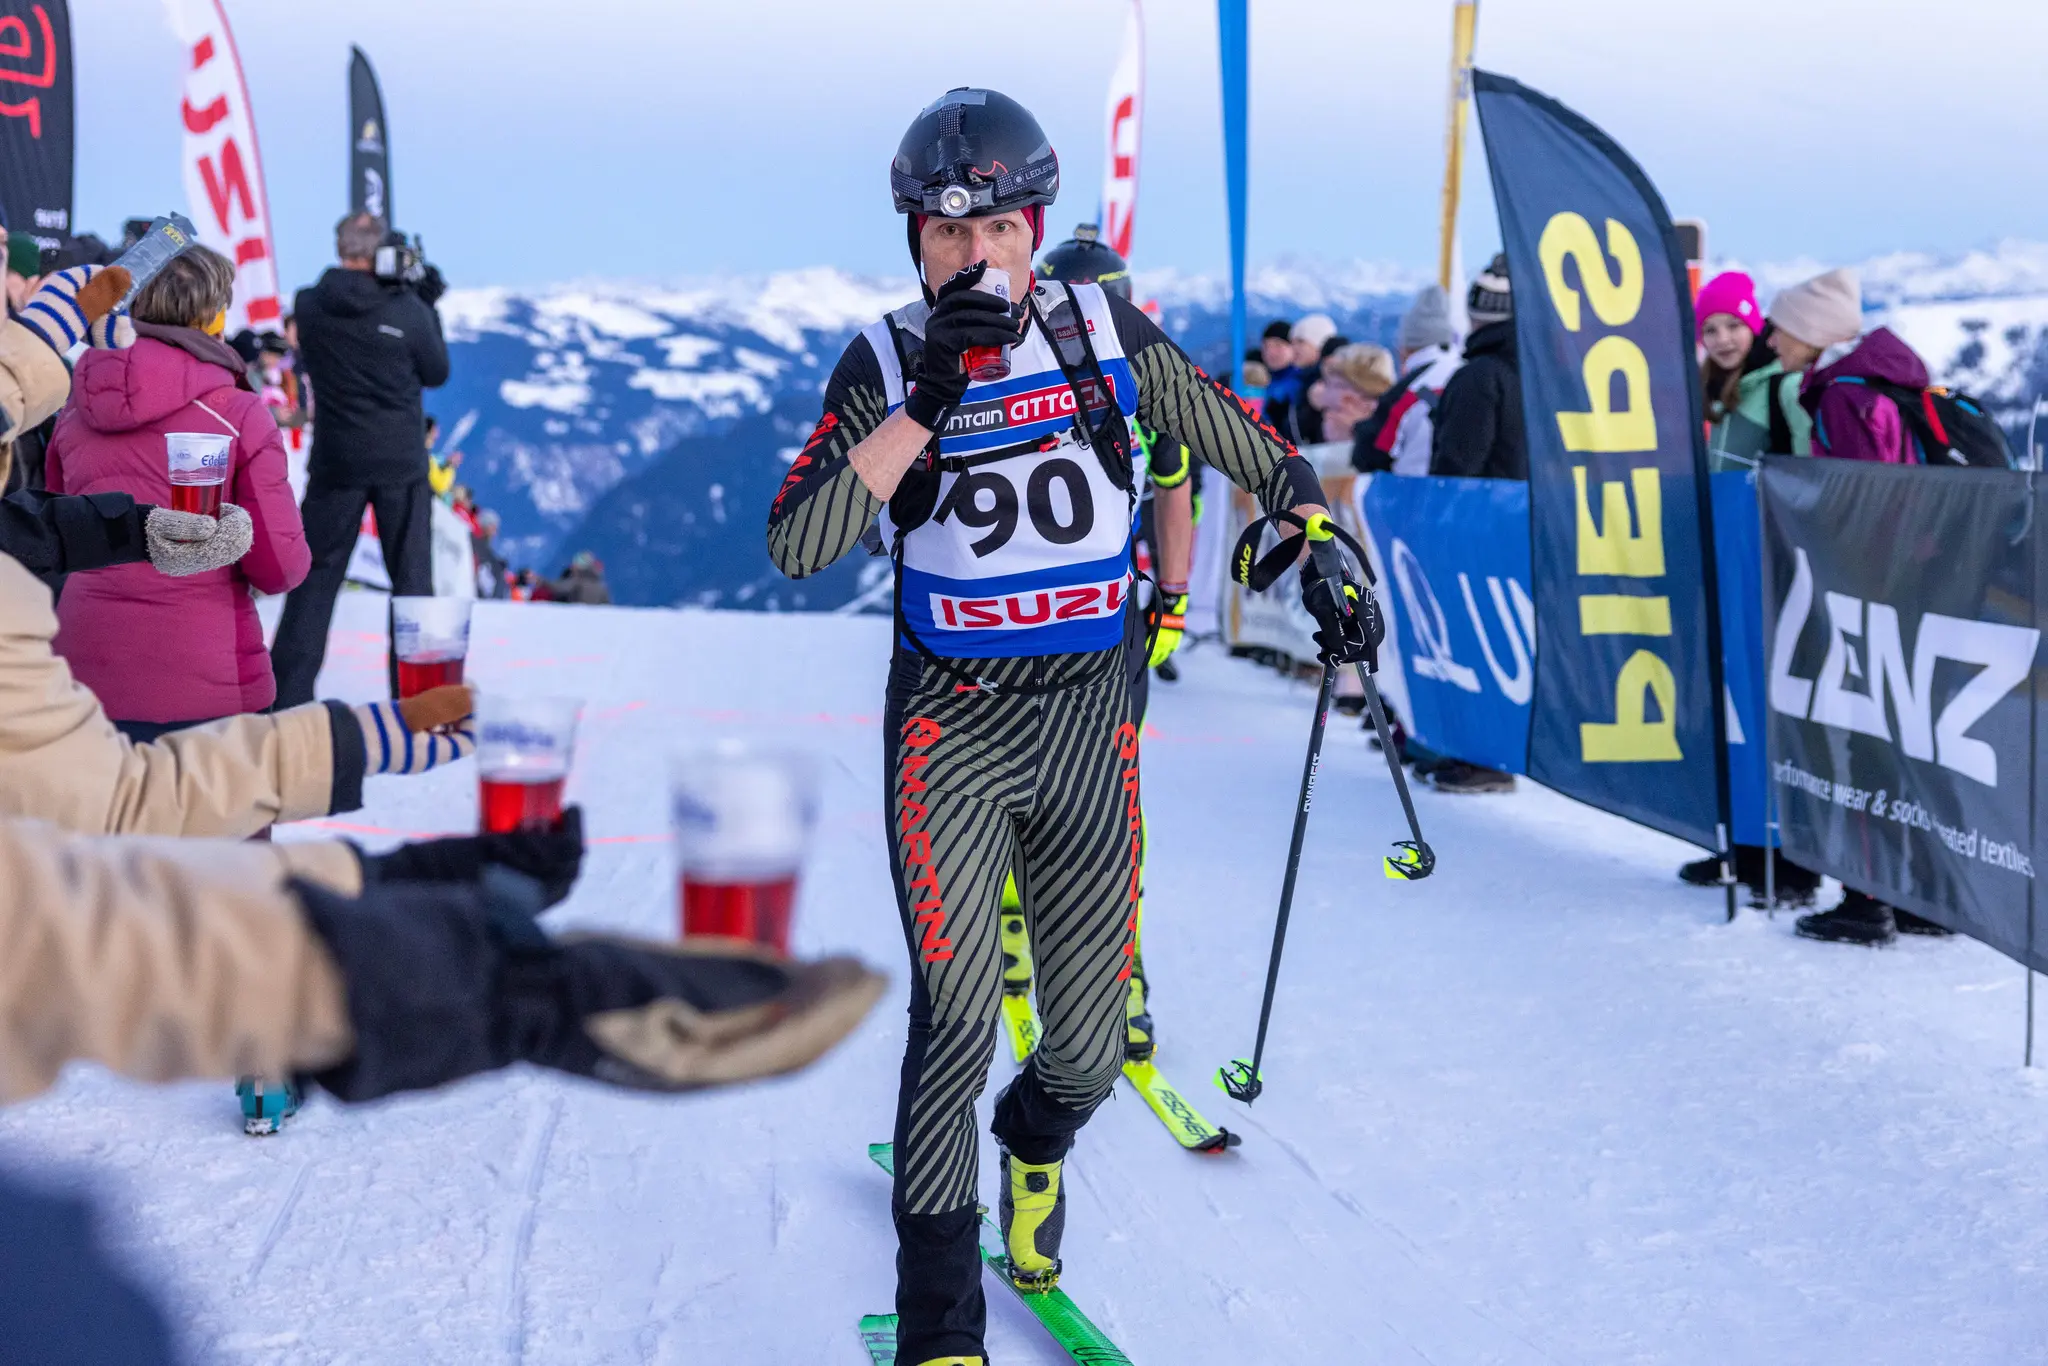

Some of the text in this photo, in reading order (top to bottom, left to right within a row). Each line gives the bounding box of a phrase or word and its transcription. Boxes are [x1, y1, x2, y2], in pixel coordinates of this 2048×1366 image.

[953, 457, 1095, 559] 90
[940, 572, 1134, 629] ISUZU
[1770, 546, 2041, 788] LENZ
[901, 755, 955, 963] MARTINI
[1832, 782, 1872, 810] wear
[1870, 788, 1887, 817] &
[1980, 834, 2037, 879] textiles
